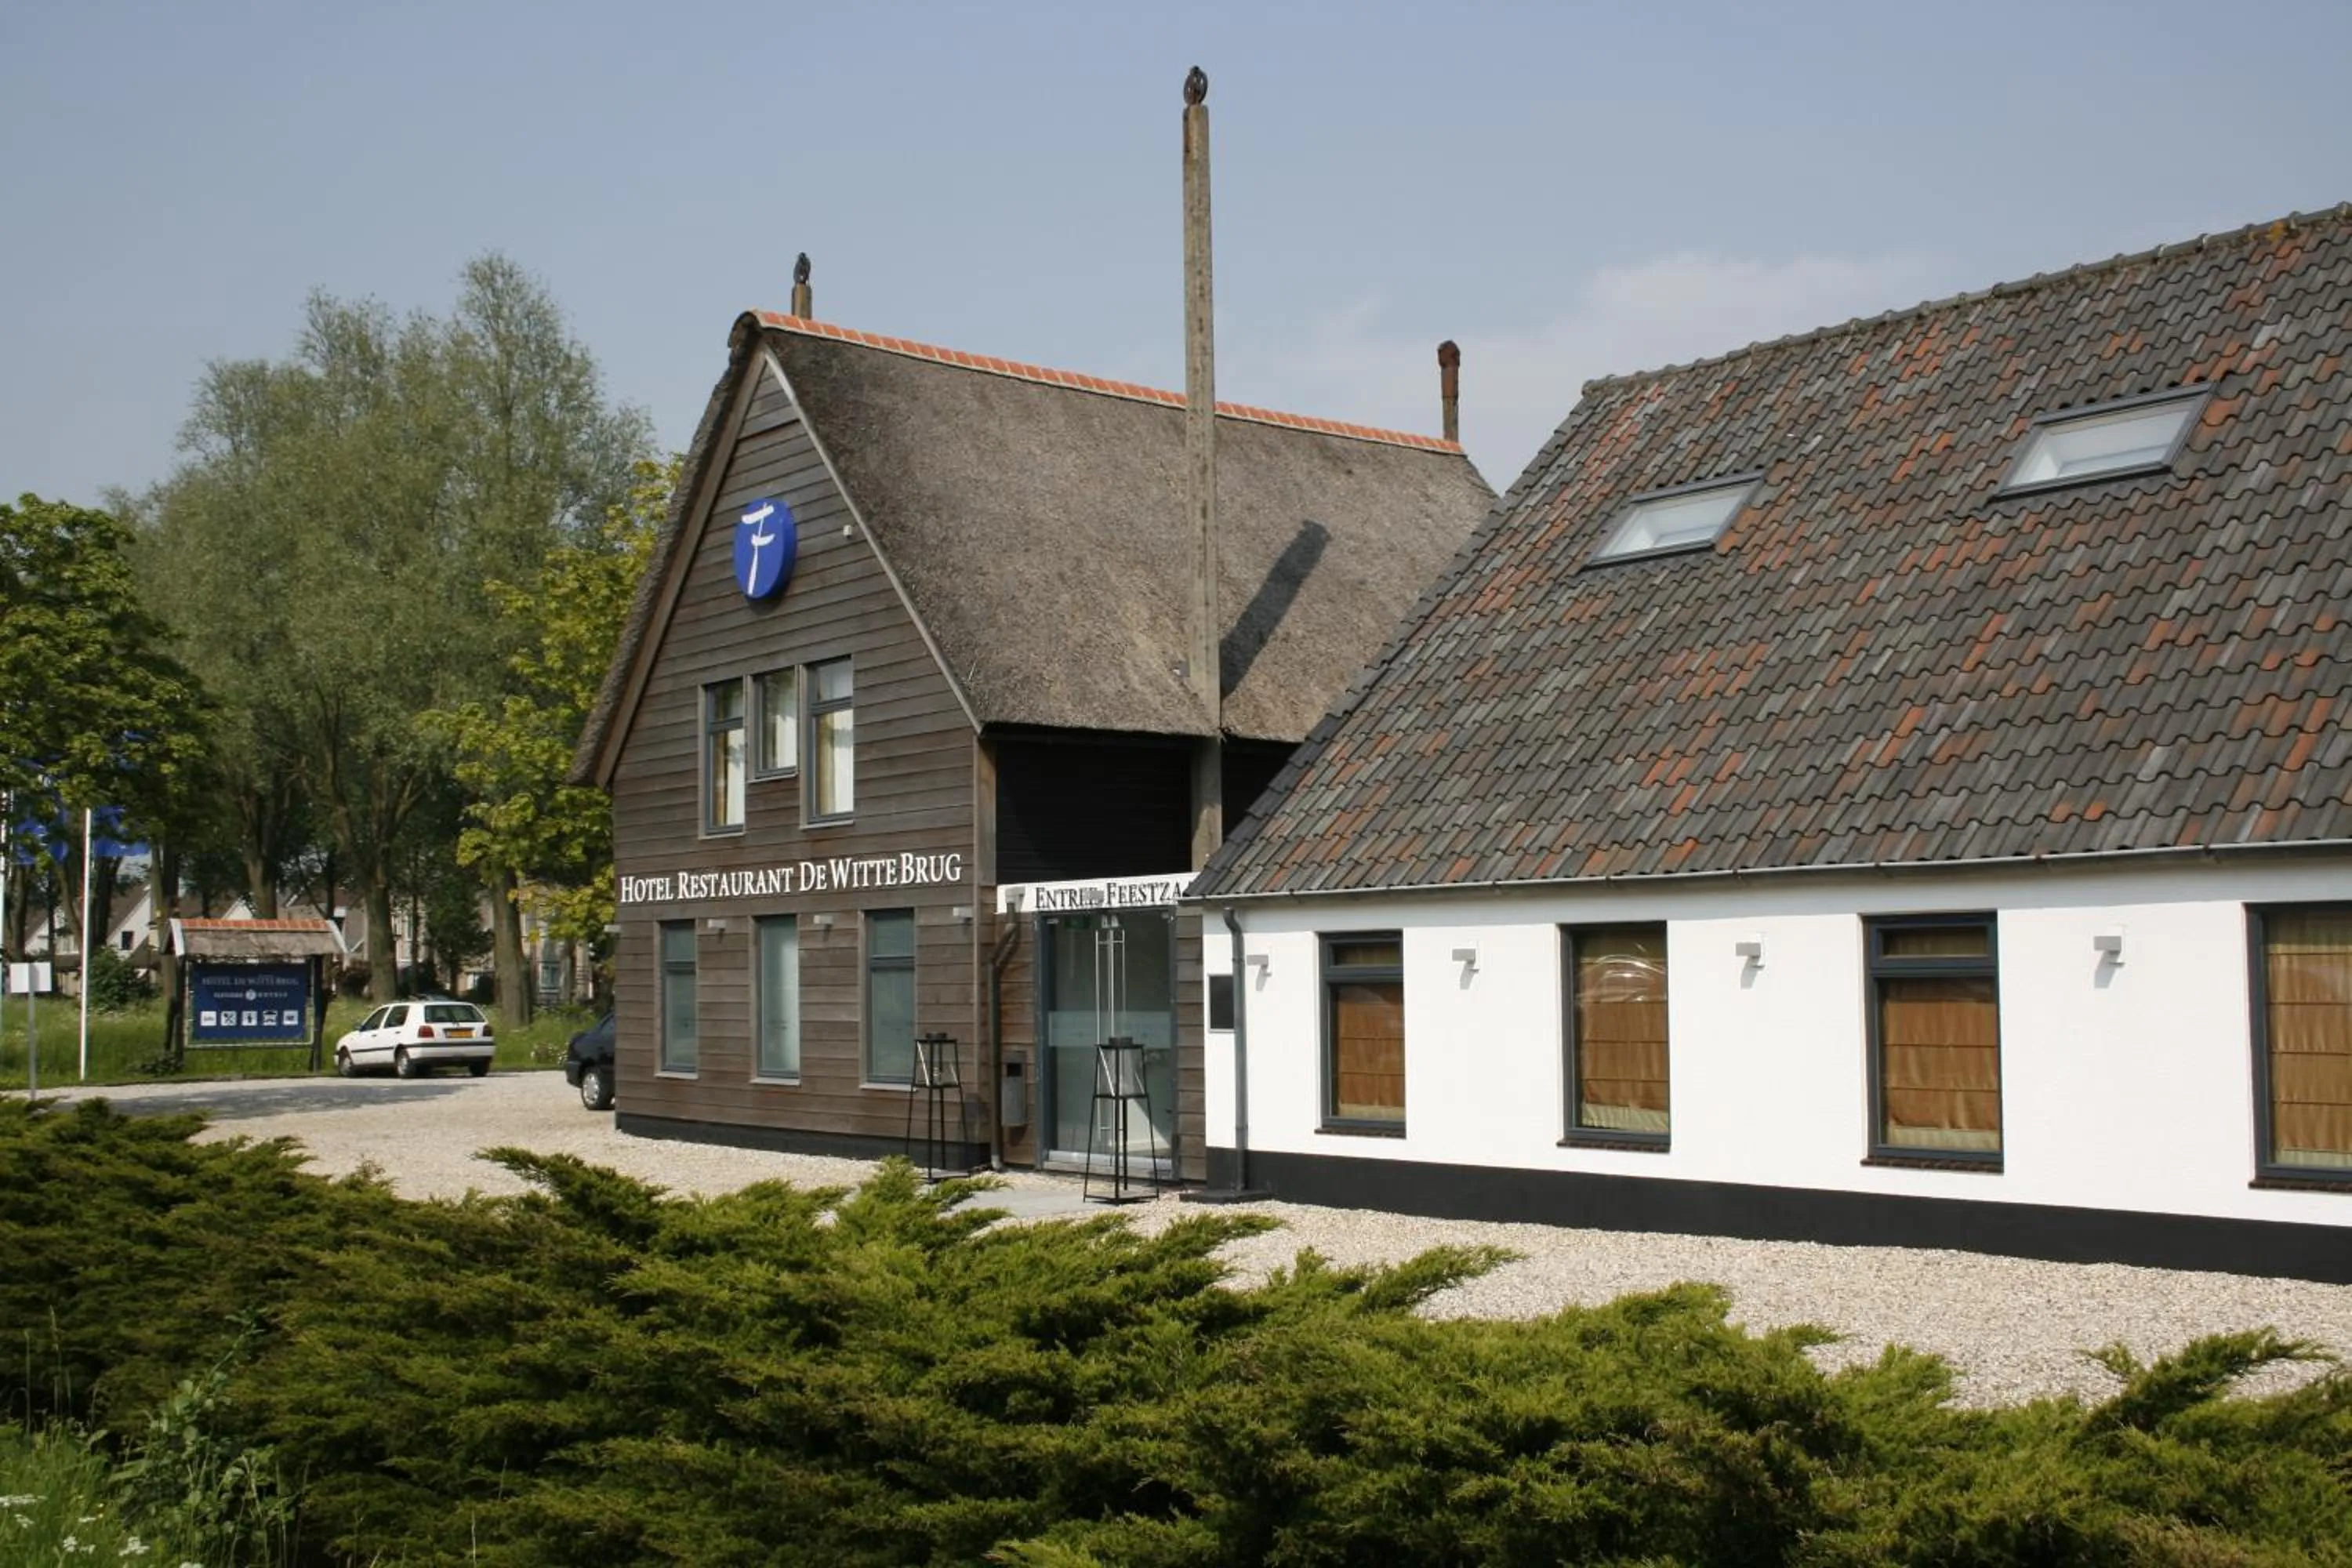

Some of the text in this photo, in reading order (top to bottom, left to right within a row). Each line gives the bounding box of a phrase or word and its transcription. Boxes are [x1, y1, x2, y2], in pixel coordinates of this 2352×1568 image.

[620, 876, 673, 902] HOTEL
[677, 867, 794, 899] RESTAURANT
[1106, 881, 1188, 906] FEESTZA
